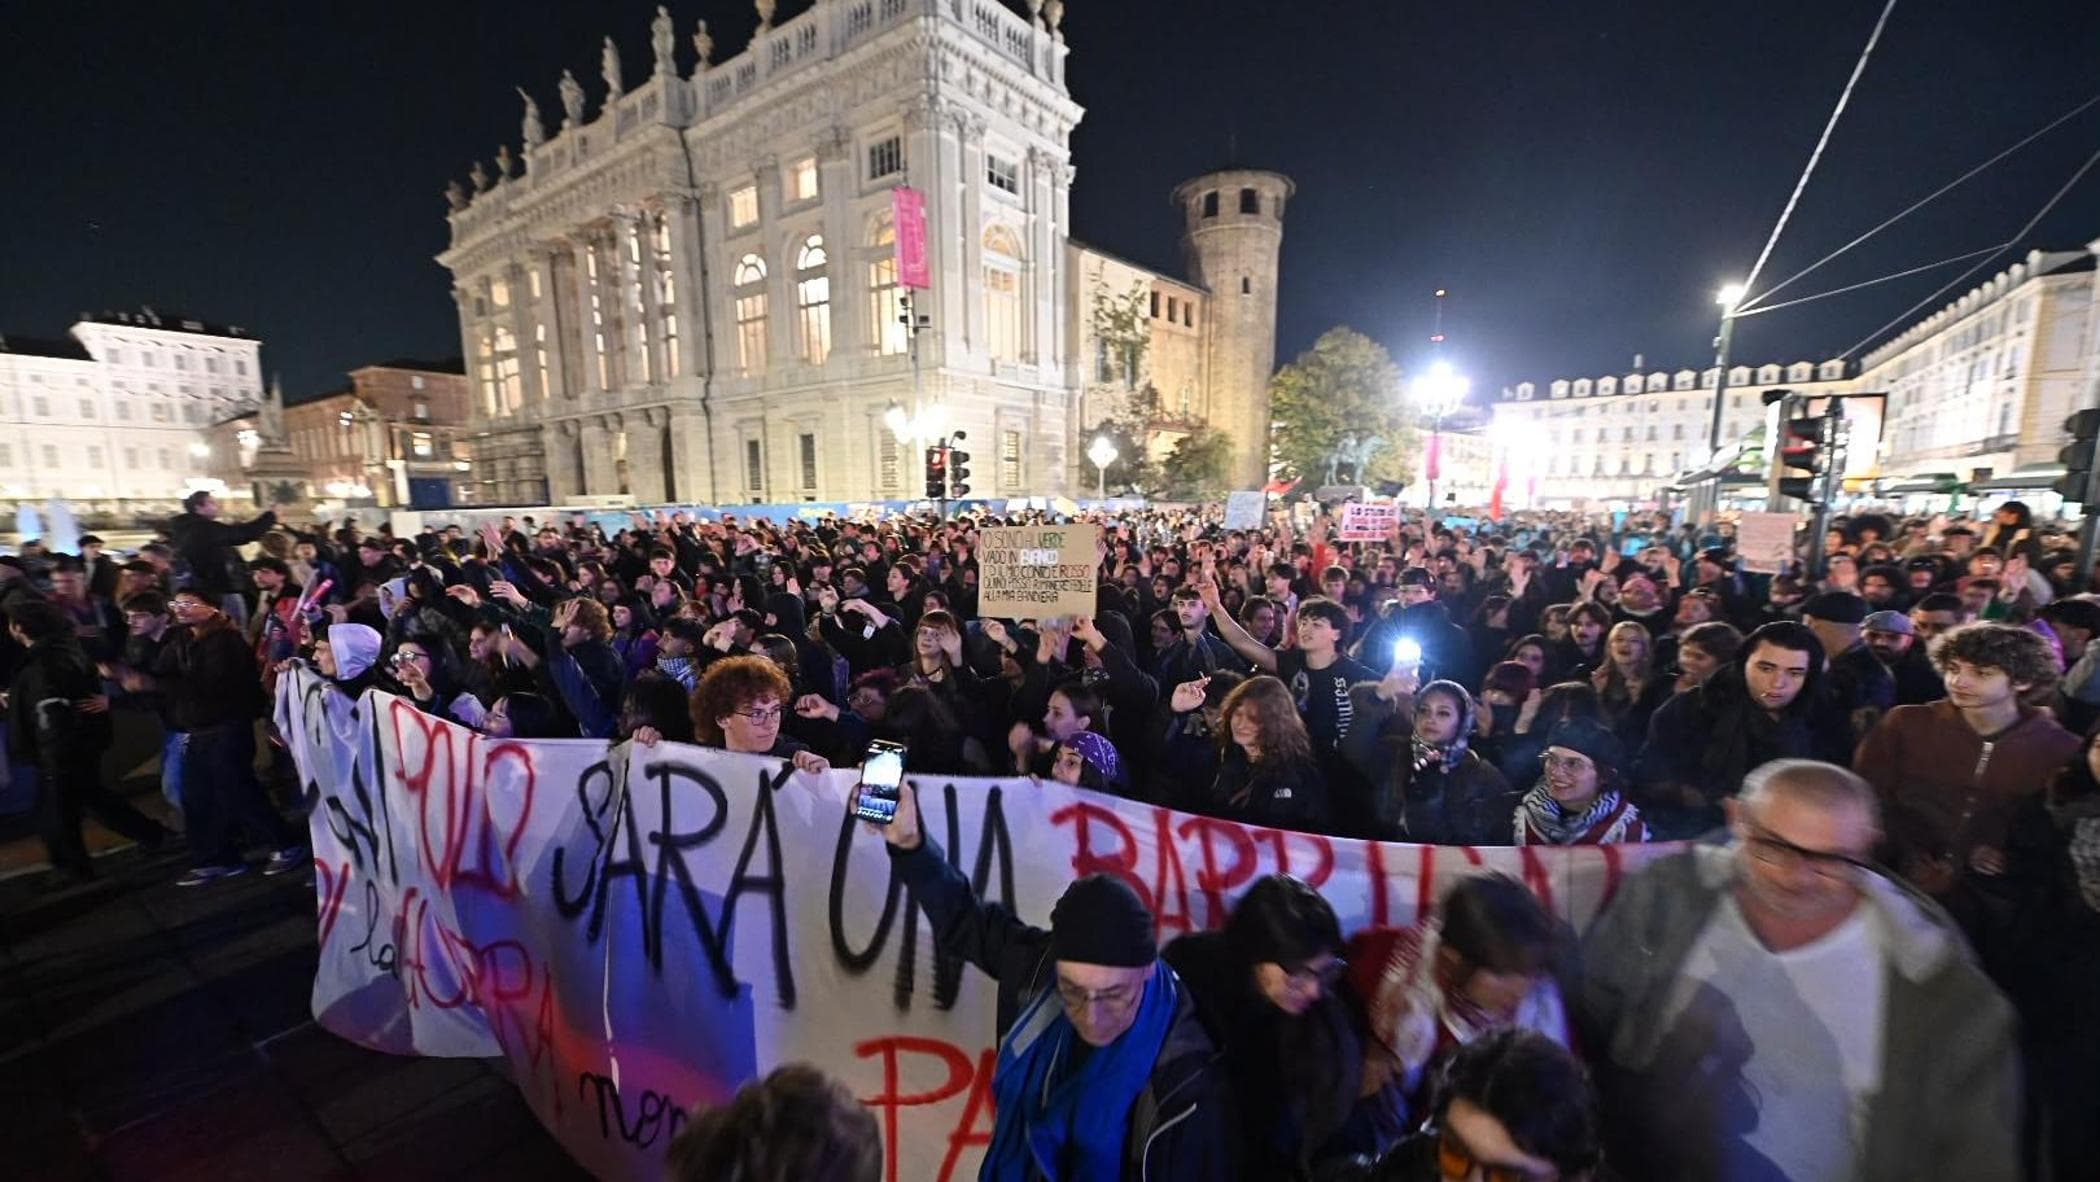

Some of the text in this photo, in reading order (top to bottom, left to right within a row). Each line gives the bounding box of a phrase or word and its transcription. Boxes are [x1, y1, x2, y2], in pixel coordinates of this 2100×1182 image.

[1039, 532, 1066, 548] VERDE
[983, 550, 1005, 565] VADO
[1008, 550, 1017, 563] IN
[1059, 565, 1091, 578] ROSSO
